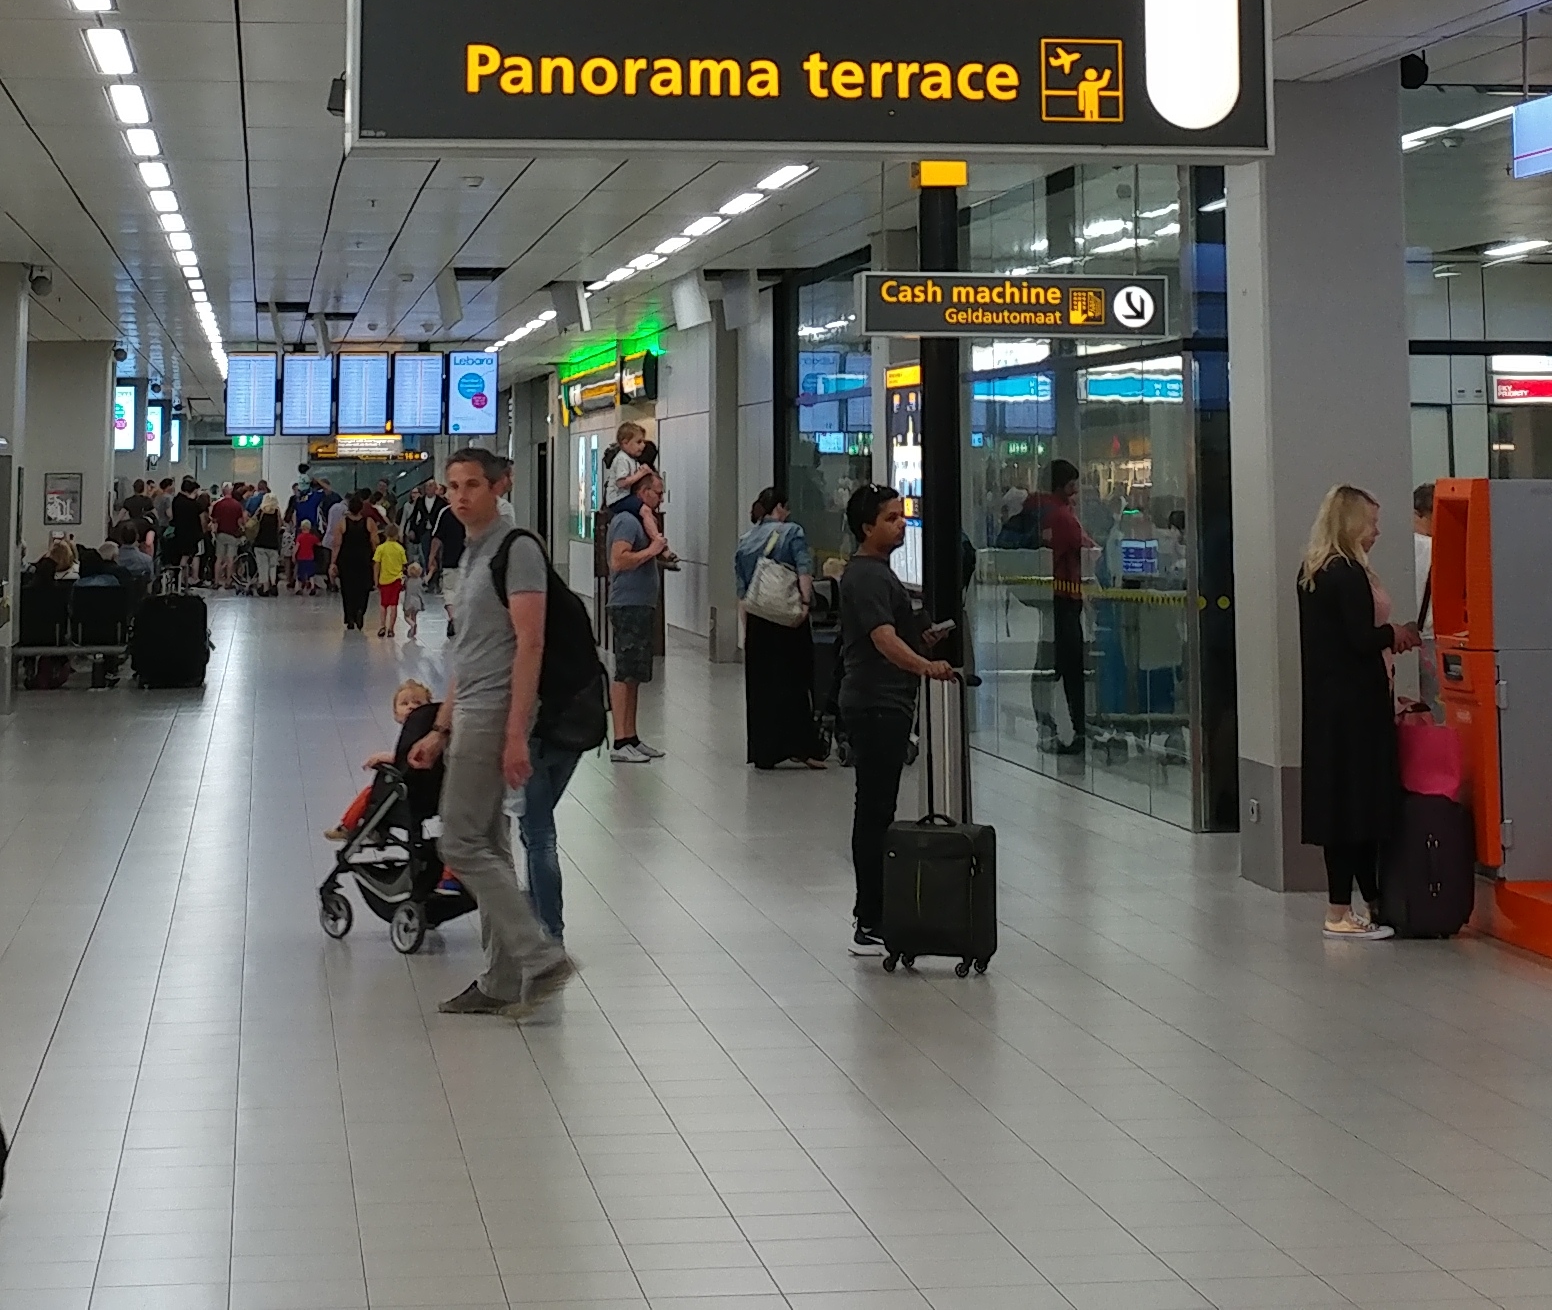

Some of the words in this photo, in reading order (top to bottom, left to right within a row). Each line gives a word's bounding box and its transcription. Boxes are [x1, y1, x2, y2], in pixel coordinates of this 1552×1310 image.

[466, 43, 779, 97] Panorama
[802, 51, 1019, 101] terrace
[881, 279, 942, 304] Cash
[952, 280, 1062, 306] machine
[944, 307, 1063, 325] Geldautomaat
